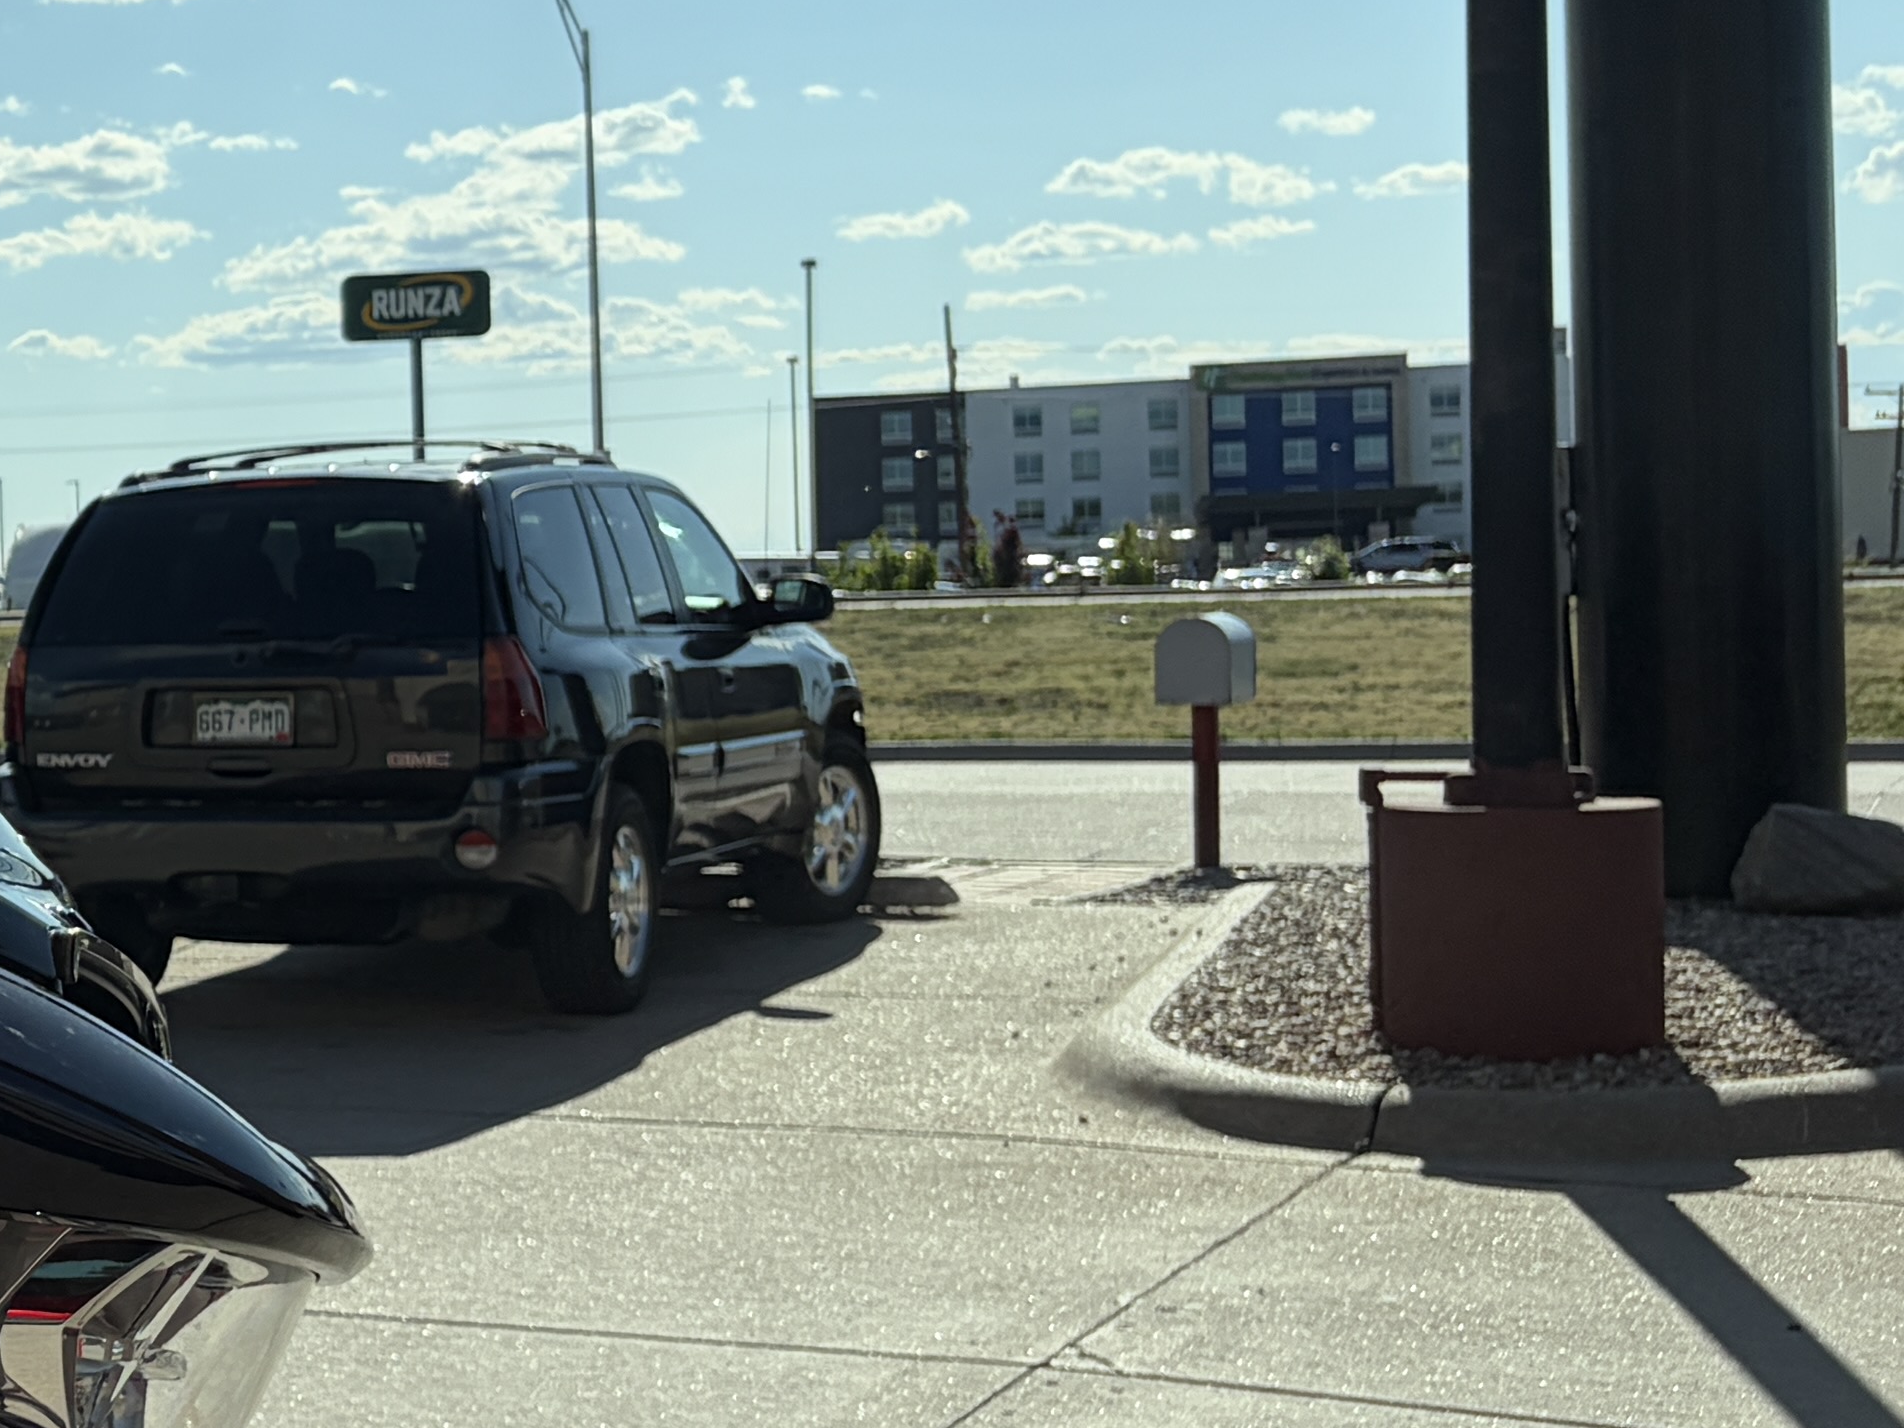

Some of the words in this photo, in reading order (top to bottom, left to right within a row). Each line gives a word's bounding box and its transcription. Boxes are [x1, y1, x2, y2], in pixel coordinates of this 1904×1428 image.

[371, 285, 462, 320] RUNZA
[36, 753, 114, 768] ENVOY
[386, 751, 451, 768] GMC
